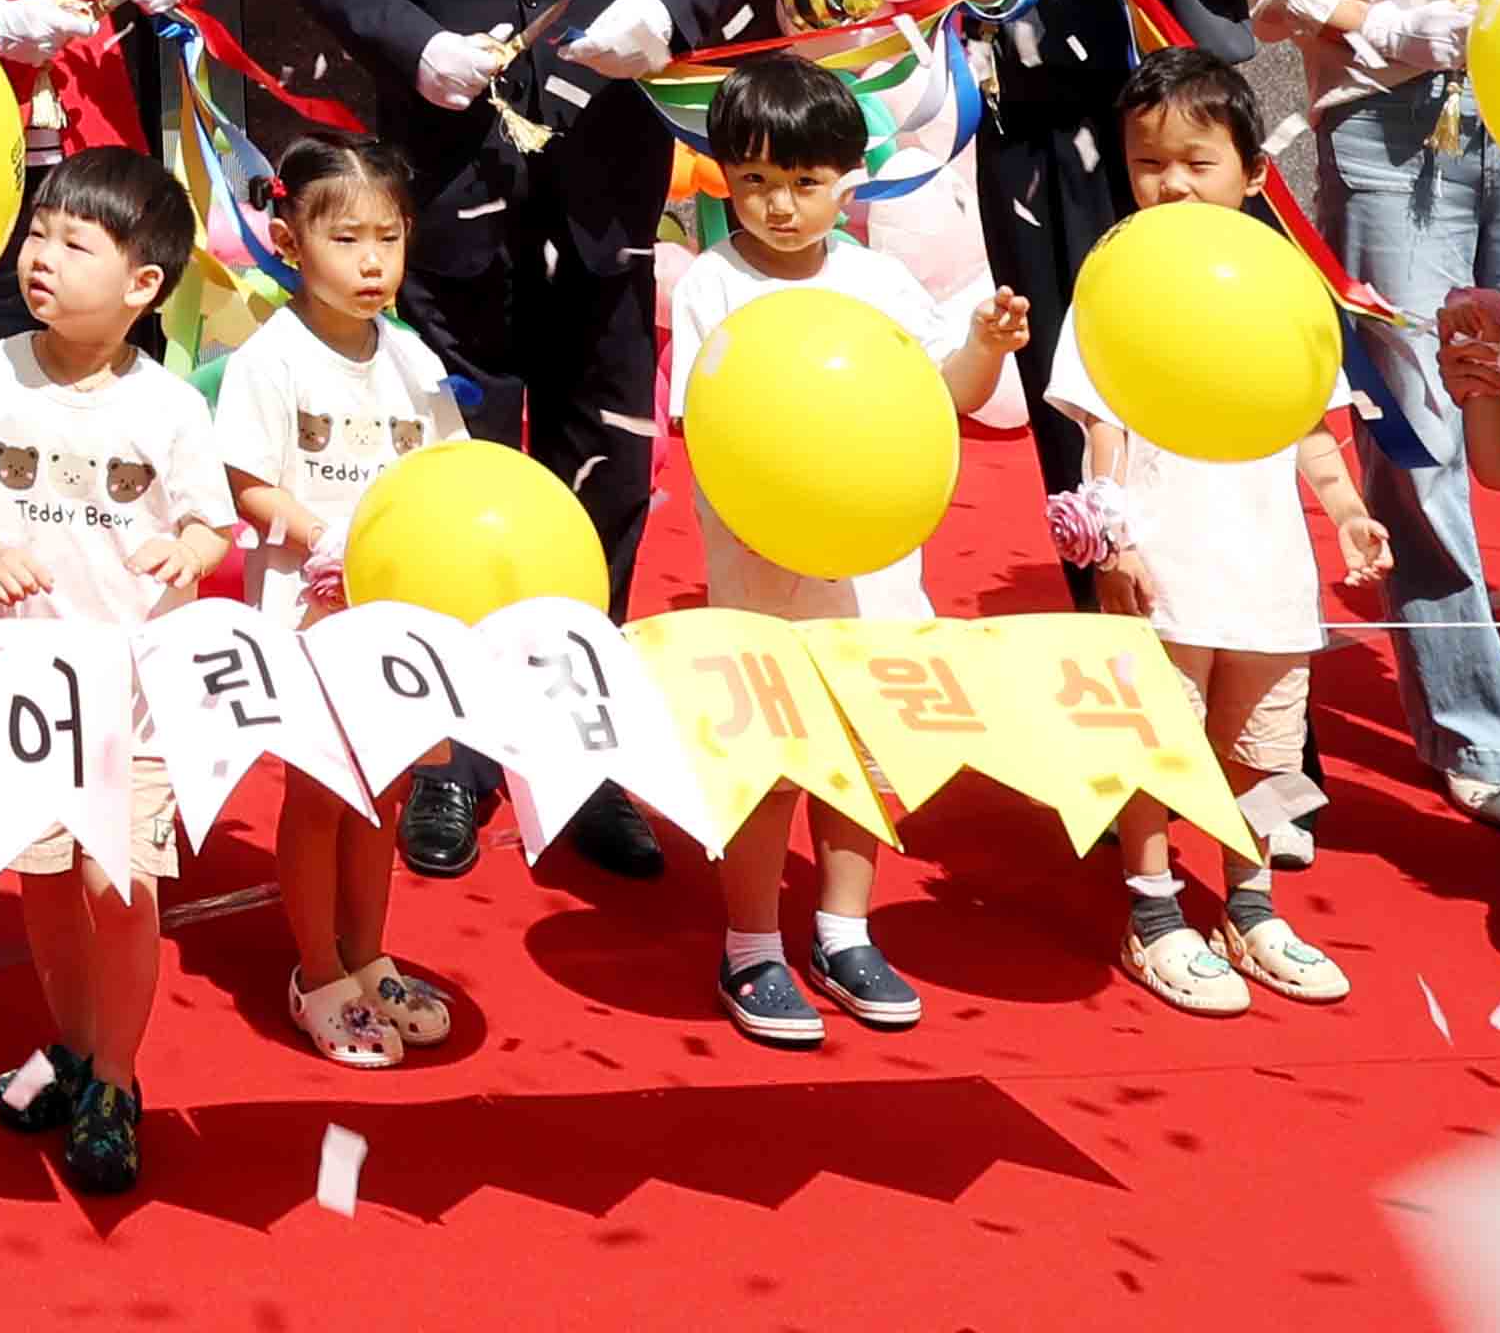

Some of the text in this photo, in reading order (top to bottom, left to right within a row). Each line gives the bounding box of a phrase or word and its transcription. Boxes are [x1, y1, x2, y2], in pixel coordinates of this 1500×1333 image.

[304, 459, 370, 482] Teddy
[14, 499, 134, 530] Teddy Bear
[6, 627, 619, 790] 어린이집
[712, 650, 1159, 751] 개원식
